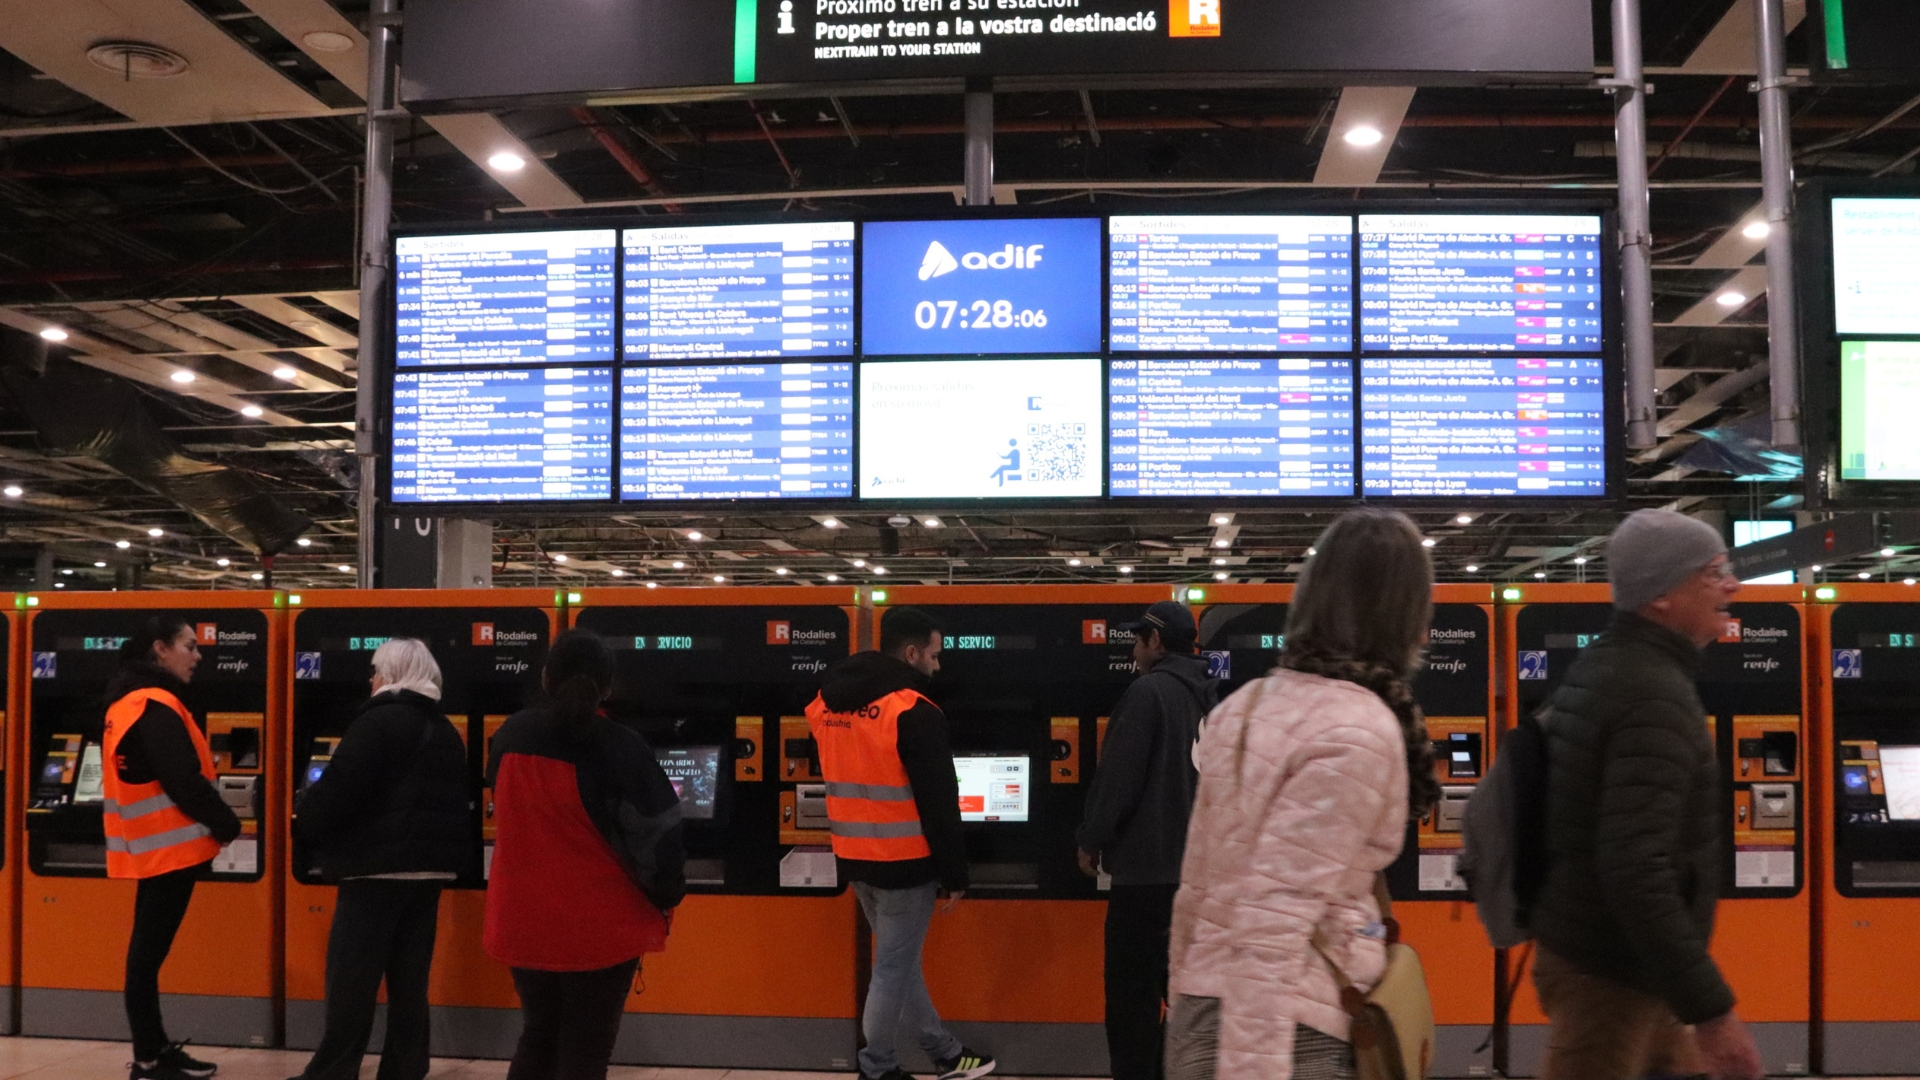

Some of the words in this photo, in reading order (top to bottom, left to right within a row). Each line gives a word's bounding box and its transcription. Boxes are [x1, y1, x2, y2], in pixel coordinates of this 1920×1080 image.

[903, 0, 942, 12] tren
[950, 0, 960, 10] a
[968, 0, 989, 10] su
[1189, 0, 1218, 24] R
[816, 22, 882, 42] Proper
[887, 20, 930, 37] tren
[936, 21, 948, 35] a
[956, 17, 973, 35] la
[980, 16, 1043, 34] vostra
[1050, 11, 1156, 33] destinació
[882, 45, 896, 56] TO
[900, 43, 930, 56] YOUR
[933, 42, 981, 55] STATION
[651, 232, 689, 241] Salidas
[1897, 226, 1920, 236] Rod
[961, 244, 1044, 269] adif
[1567, 268, 1575, 276] A
[1587, 268, 1593, 276] 2
[915, 300, 1047, 329] 07:28:06
[1390, 335, 1410, 343] Lyon
[1391, 394, 1418, 402] Sevilla
[1446, 480, 1466, 488] Lyon
[204, 626, 216, 640] R
[218, 631, 257, 640] Rodalies
[480, 626, 493, 640] R
[496, 632, 537, 640] Rodalies
[775, 624, 789, 639] R
[792, 630, 836, 640] Rodalies
[1091, 623, 1106, 638] R
[1430, 629, 1475, 639] Rodalies
[1726, 622, 1740, 637] R
[1743, 628, 1788, 637] Rodalies
[944, 636, 954, 649] EN
[1261, 635, 1273, 648] EN
[217, 659, 248, 673] renfe
[495, 660, 528, 674] renfe
[792, 660, 827, 674] renfe
[1430, 659, 1466, 674] renfe
[1743, 658, 1779, 672] renfe
